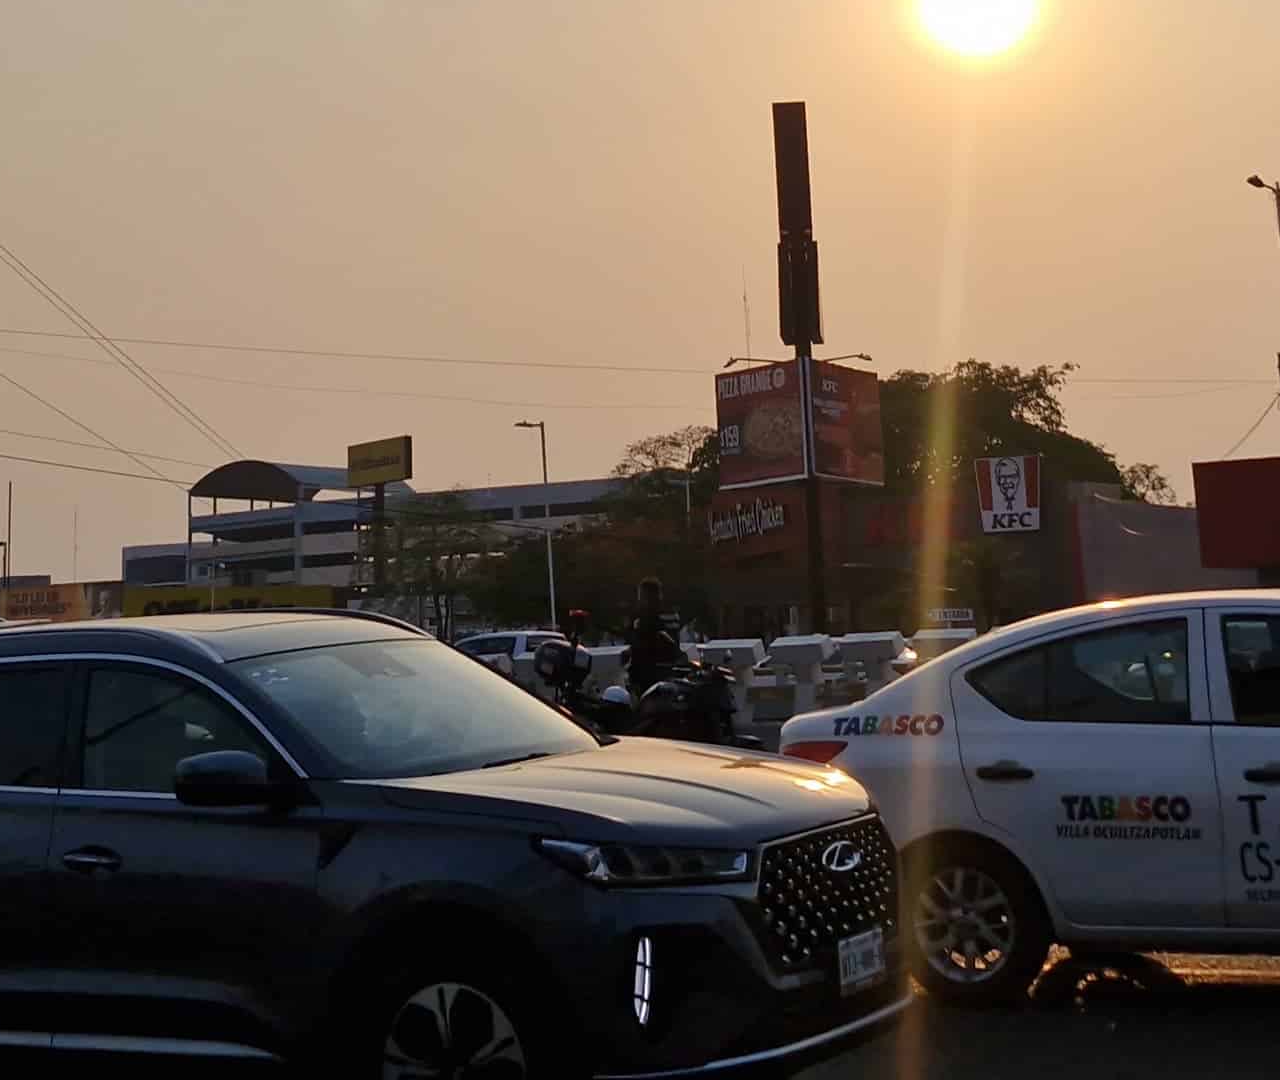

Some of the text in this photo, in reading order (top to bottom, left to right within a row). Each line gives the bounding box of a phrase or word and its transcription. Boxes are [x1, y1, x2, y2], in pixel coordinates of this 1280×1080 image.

[718, 378, 738, 400] PIZZA
[740, 368, 772, 395] GRANDE
[736, 503, 756, 542] Fried
[756, 496, 785, 536] Chicken
[991, 511, 1033, 530] KFC
[833, 713, 945, 736] TABASCO
[1061, 795, 1191, 822] TABASCO
[1056, 824, 1089, 839] VILLA
